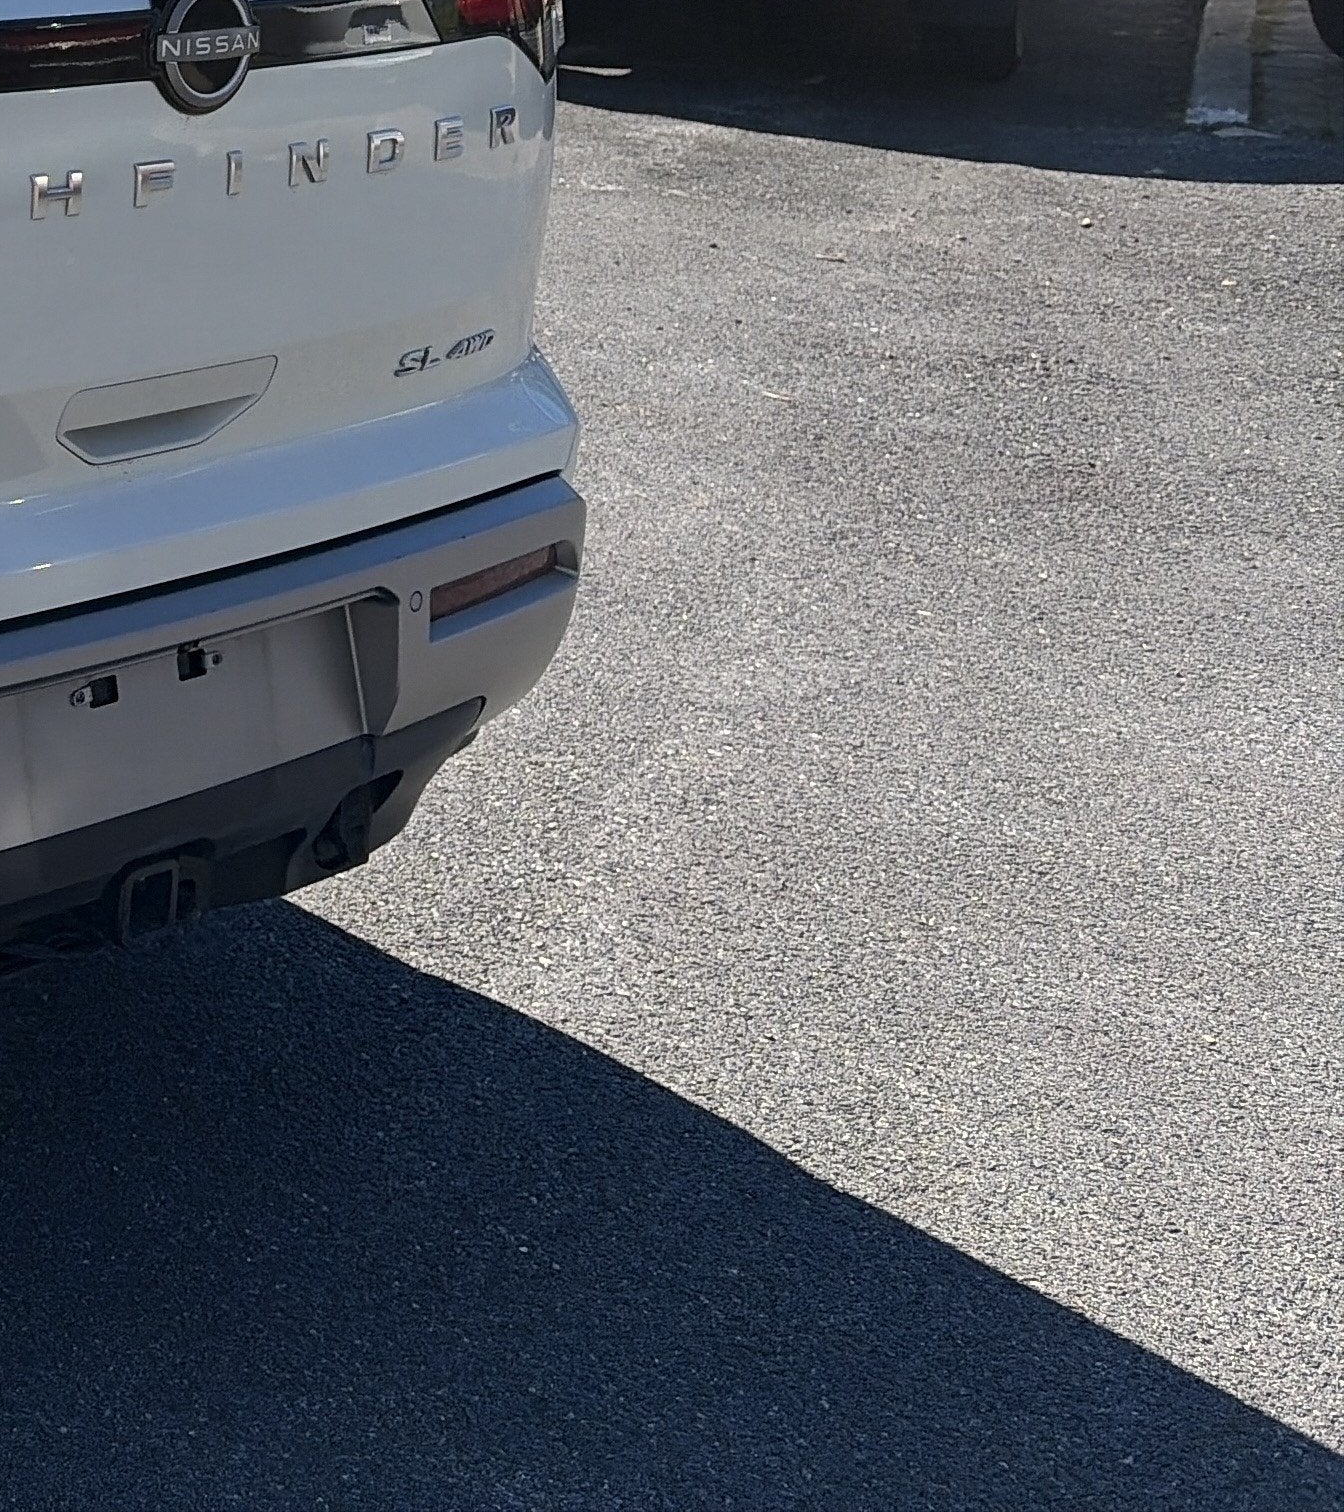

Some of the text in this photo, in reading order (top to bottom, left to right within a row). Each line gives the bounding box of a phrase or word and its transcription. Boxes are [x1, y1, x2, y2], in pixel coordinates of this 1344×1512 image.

[161, 31, 260, 58] NISSAN
[393, 328, 496, 378] SL 4WD
